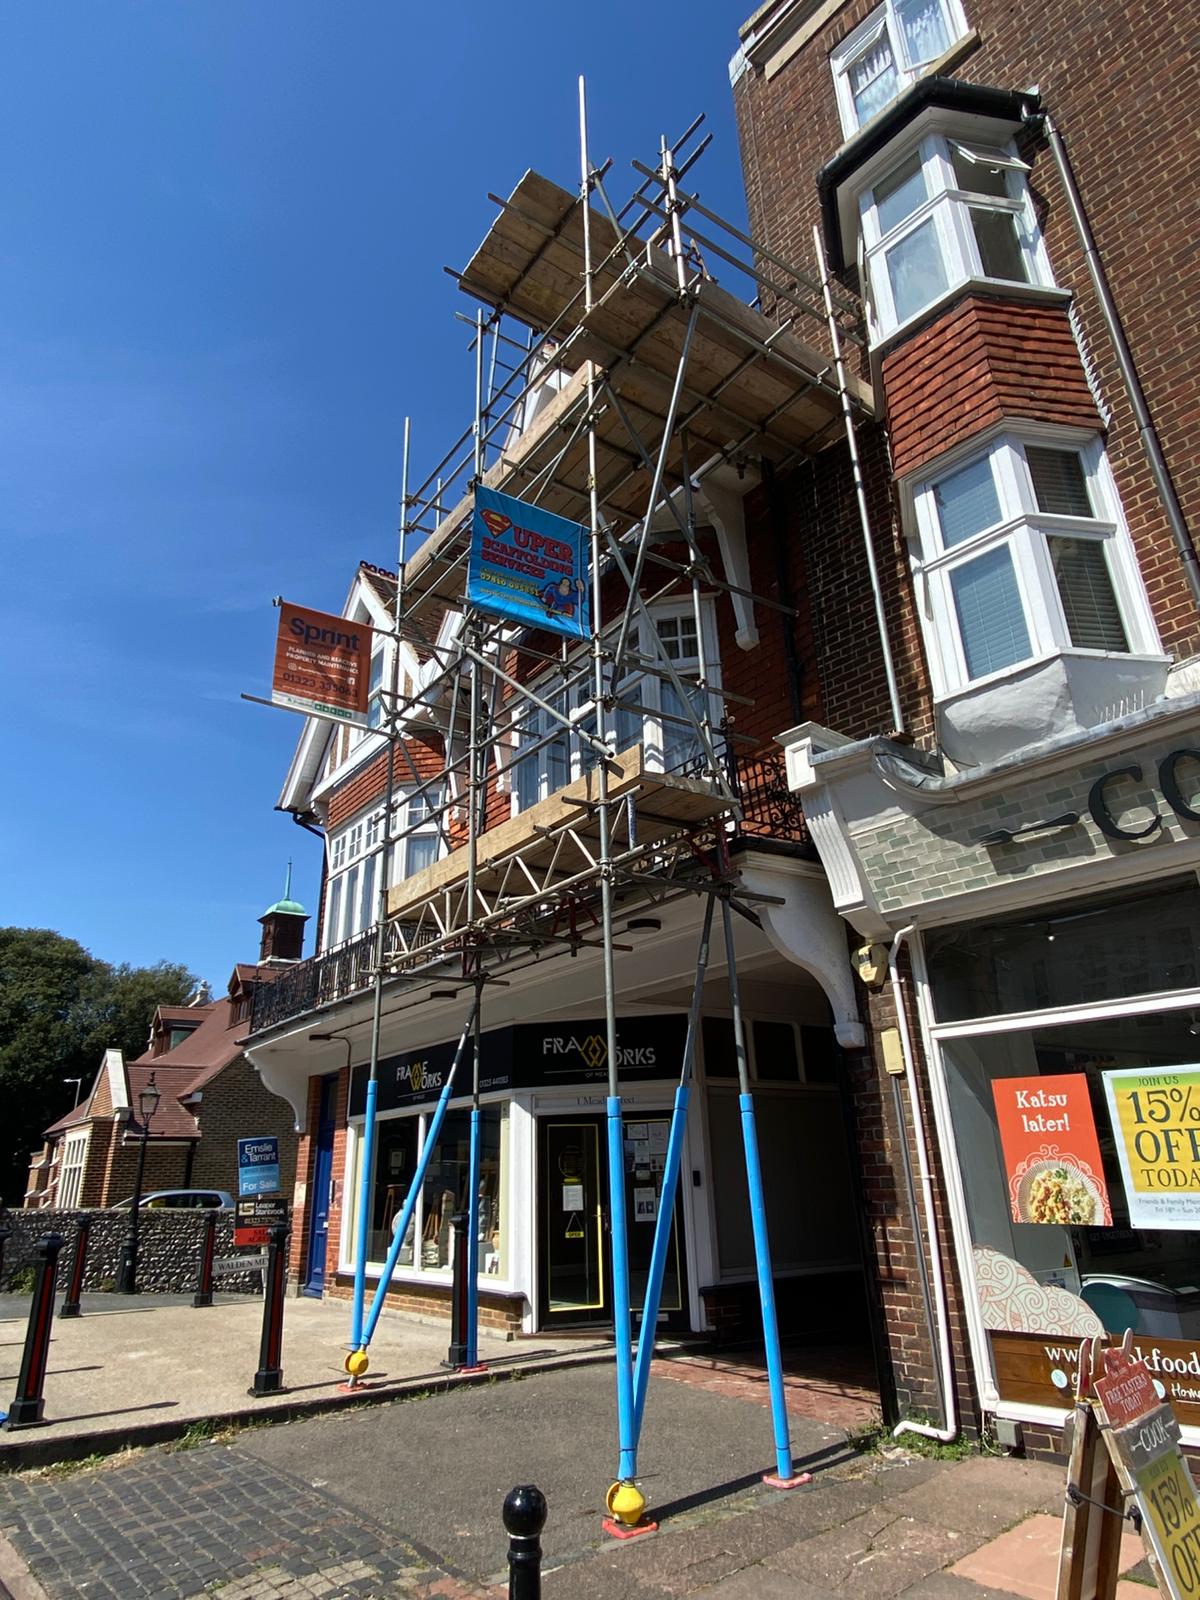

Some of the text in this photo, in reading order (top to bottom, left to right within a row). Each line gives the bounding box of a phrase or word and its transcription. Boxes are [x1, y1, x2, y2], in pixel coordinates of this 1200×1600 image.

[290, 617, 360, 651] Sprint
[1138, 1075, 1179, 1087] JOIN US
[1016, 1090, 1068, 1109] Katsu
[1127, 1086, 1200, 1125] 15%
[1021, 1113, 1070, 1133] later!
[242, 1152, 276, 1164] & Tarrant
[245, 1143, 273, 1154] Emslie
[243, 1180, 277, 1191] For Sale
[1140, 1168, 1200, 1187] TODA
[256, 1202, 276, 1210] Leaper
[1105, 1388, 1121, 1405] FREE
[1140, 1418, 1170, 1452] COOK
[1151, 1470, 1194, 1537] 15%
